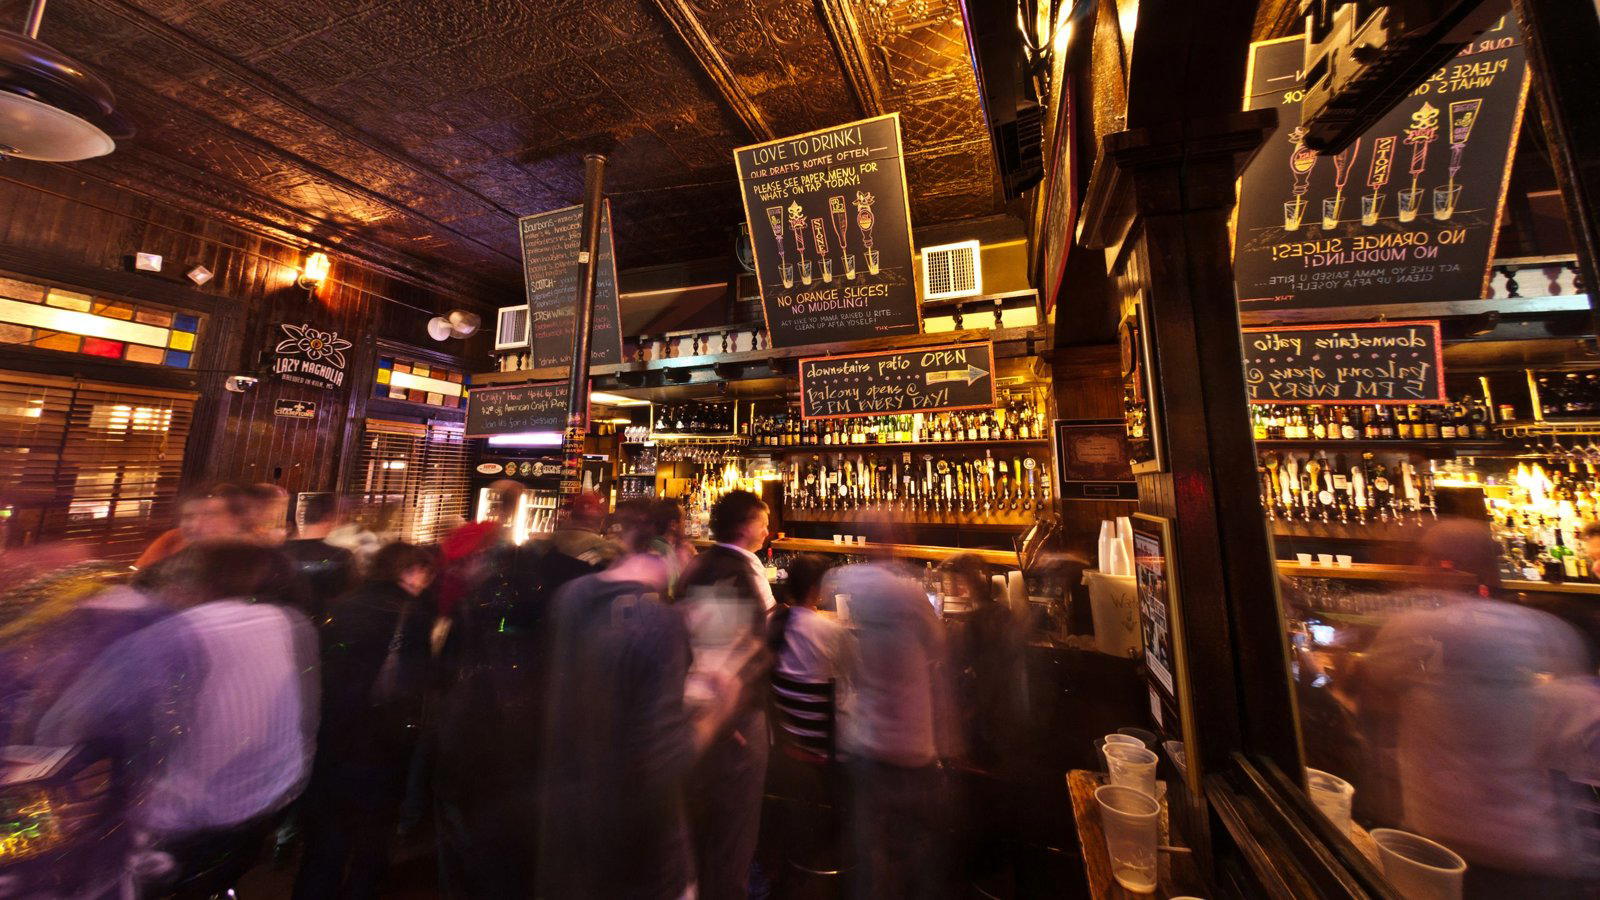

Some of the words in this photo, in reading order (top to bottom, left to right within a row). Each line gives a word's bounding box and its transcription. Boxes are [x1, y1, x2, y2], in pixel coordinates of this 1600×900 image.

[750, 171, 767, 179] OUR
[769, 162, 800, 175] DRAFTS
[803, 155, 833, 169] ROTATE
[836, 147, 869, 161] OFTEN
[753, 144, 787, 166] LOVE
[789, 140, 809, 158] TO
[753, 180, 782, 195] PLEASE
[783, 177, 799, 187] SEE
[800, 171, 825, 184] PAPER
[828, 166, 855, 180] MENU
[860, 162, 878, 173] FOR
[792, 184, 804, 194] ON
[805, 182, 822, 193] TAP
[826, 174, 861, 189] TODAY!
[777, 295, 792, 308] NO
[797, 289, 838, 304] ORANGE
[844, 284, 889, 299] SLICES!
[792, 304, 805, 315] NO
[808, 297, 868, 313] MUDDLING!
[841, 312, 863, 320] RAISED
[276, 358, 300, 374] LAZY
[301, 360, 344, 387] MAGNOLIA
[807, 361, 871, 378] downstairs
[878, 356, 910, 376] patio
[921, 348, 967, 367] OPEN
[807, 385, 859, 402] balcony
[866, 384, 902, 398] opens
[906, 383, 919, 396] @
[811, 401, 823, 416] 5
[828, 401, 851, 414] PM
[859, 396, 904, 412] EVERY
[912, 388, 949, 408] DAY!
